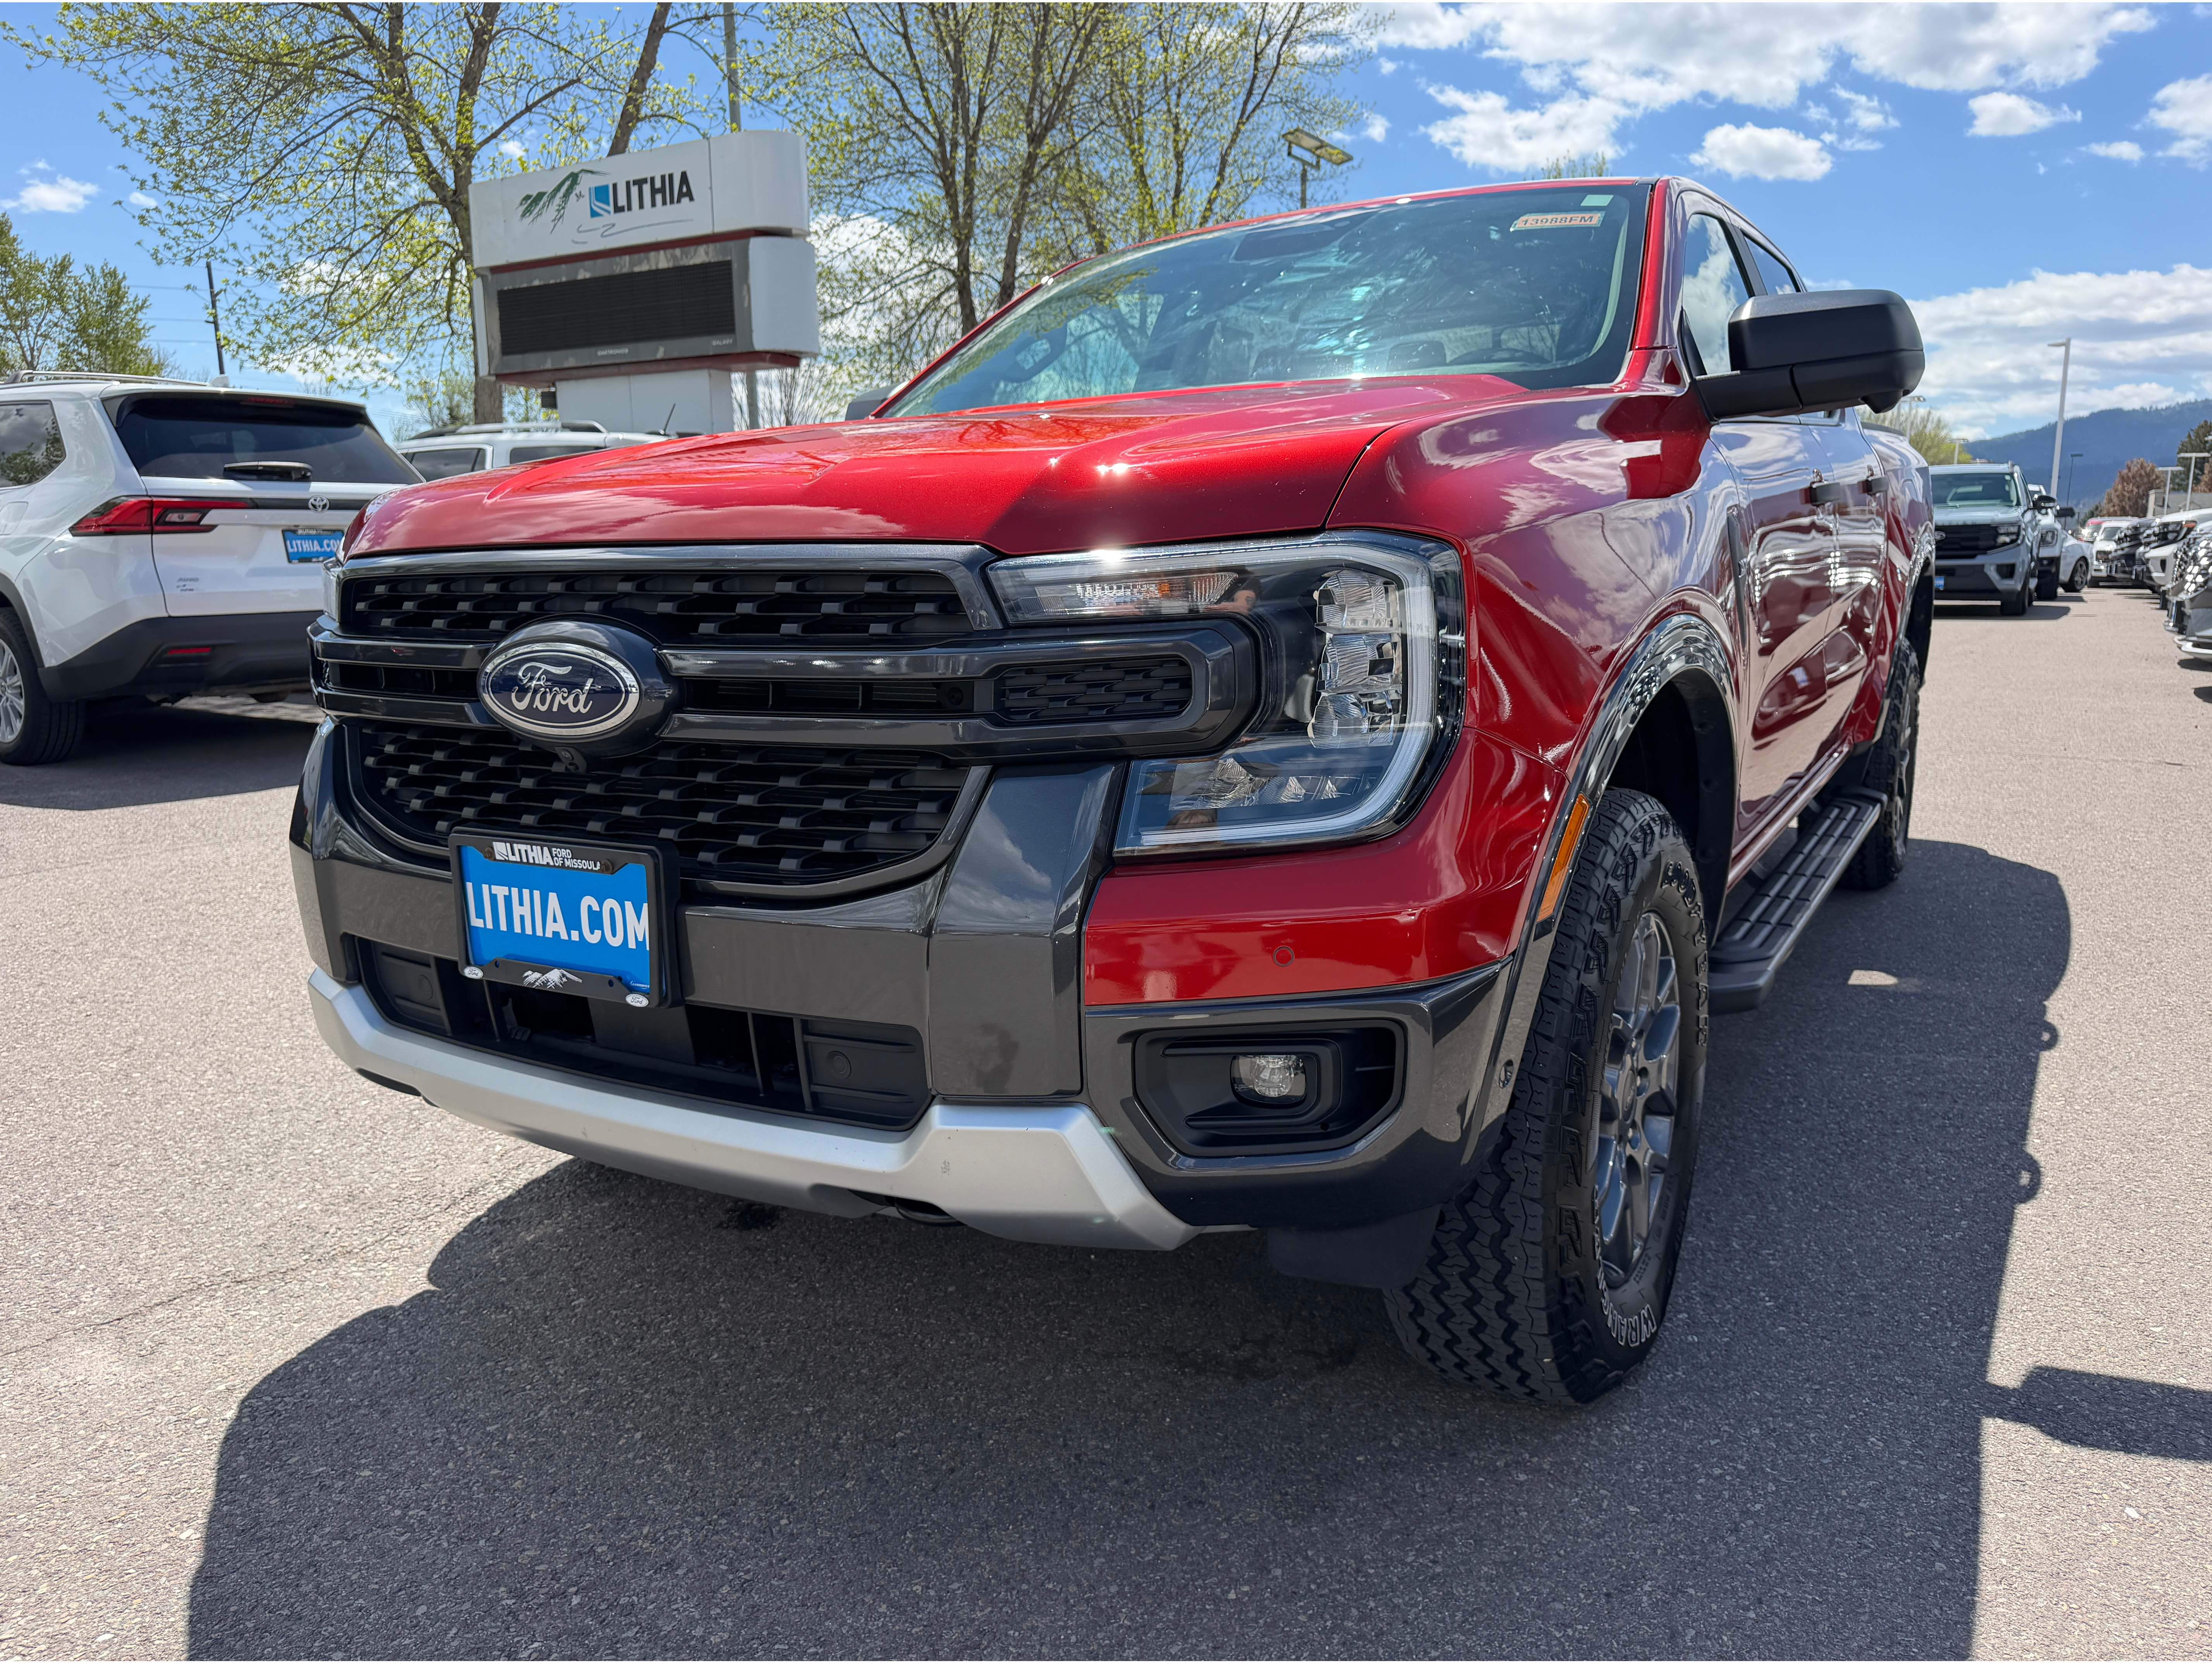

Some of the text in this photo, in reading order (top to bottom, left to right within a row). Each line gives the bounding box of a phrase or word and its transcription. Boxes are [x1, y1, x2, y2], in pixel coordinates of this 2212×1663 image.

[612, 170, 695, 214] LITHIA
[1522, 215, 1594, 226] 13988FM
[511, 662, 595, 714] Ford
[506, 842, 554, 866] LITHIA
[552, 848, 572, 858] FORD
[554, 857, 601, 870] OF MISSOULA
[466, 882, 650, 951] LITHIA.COM
